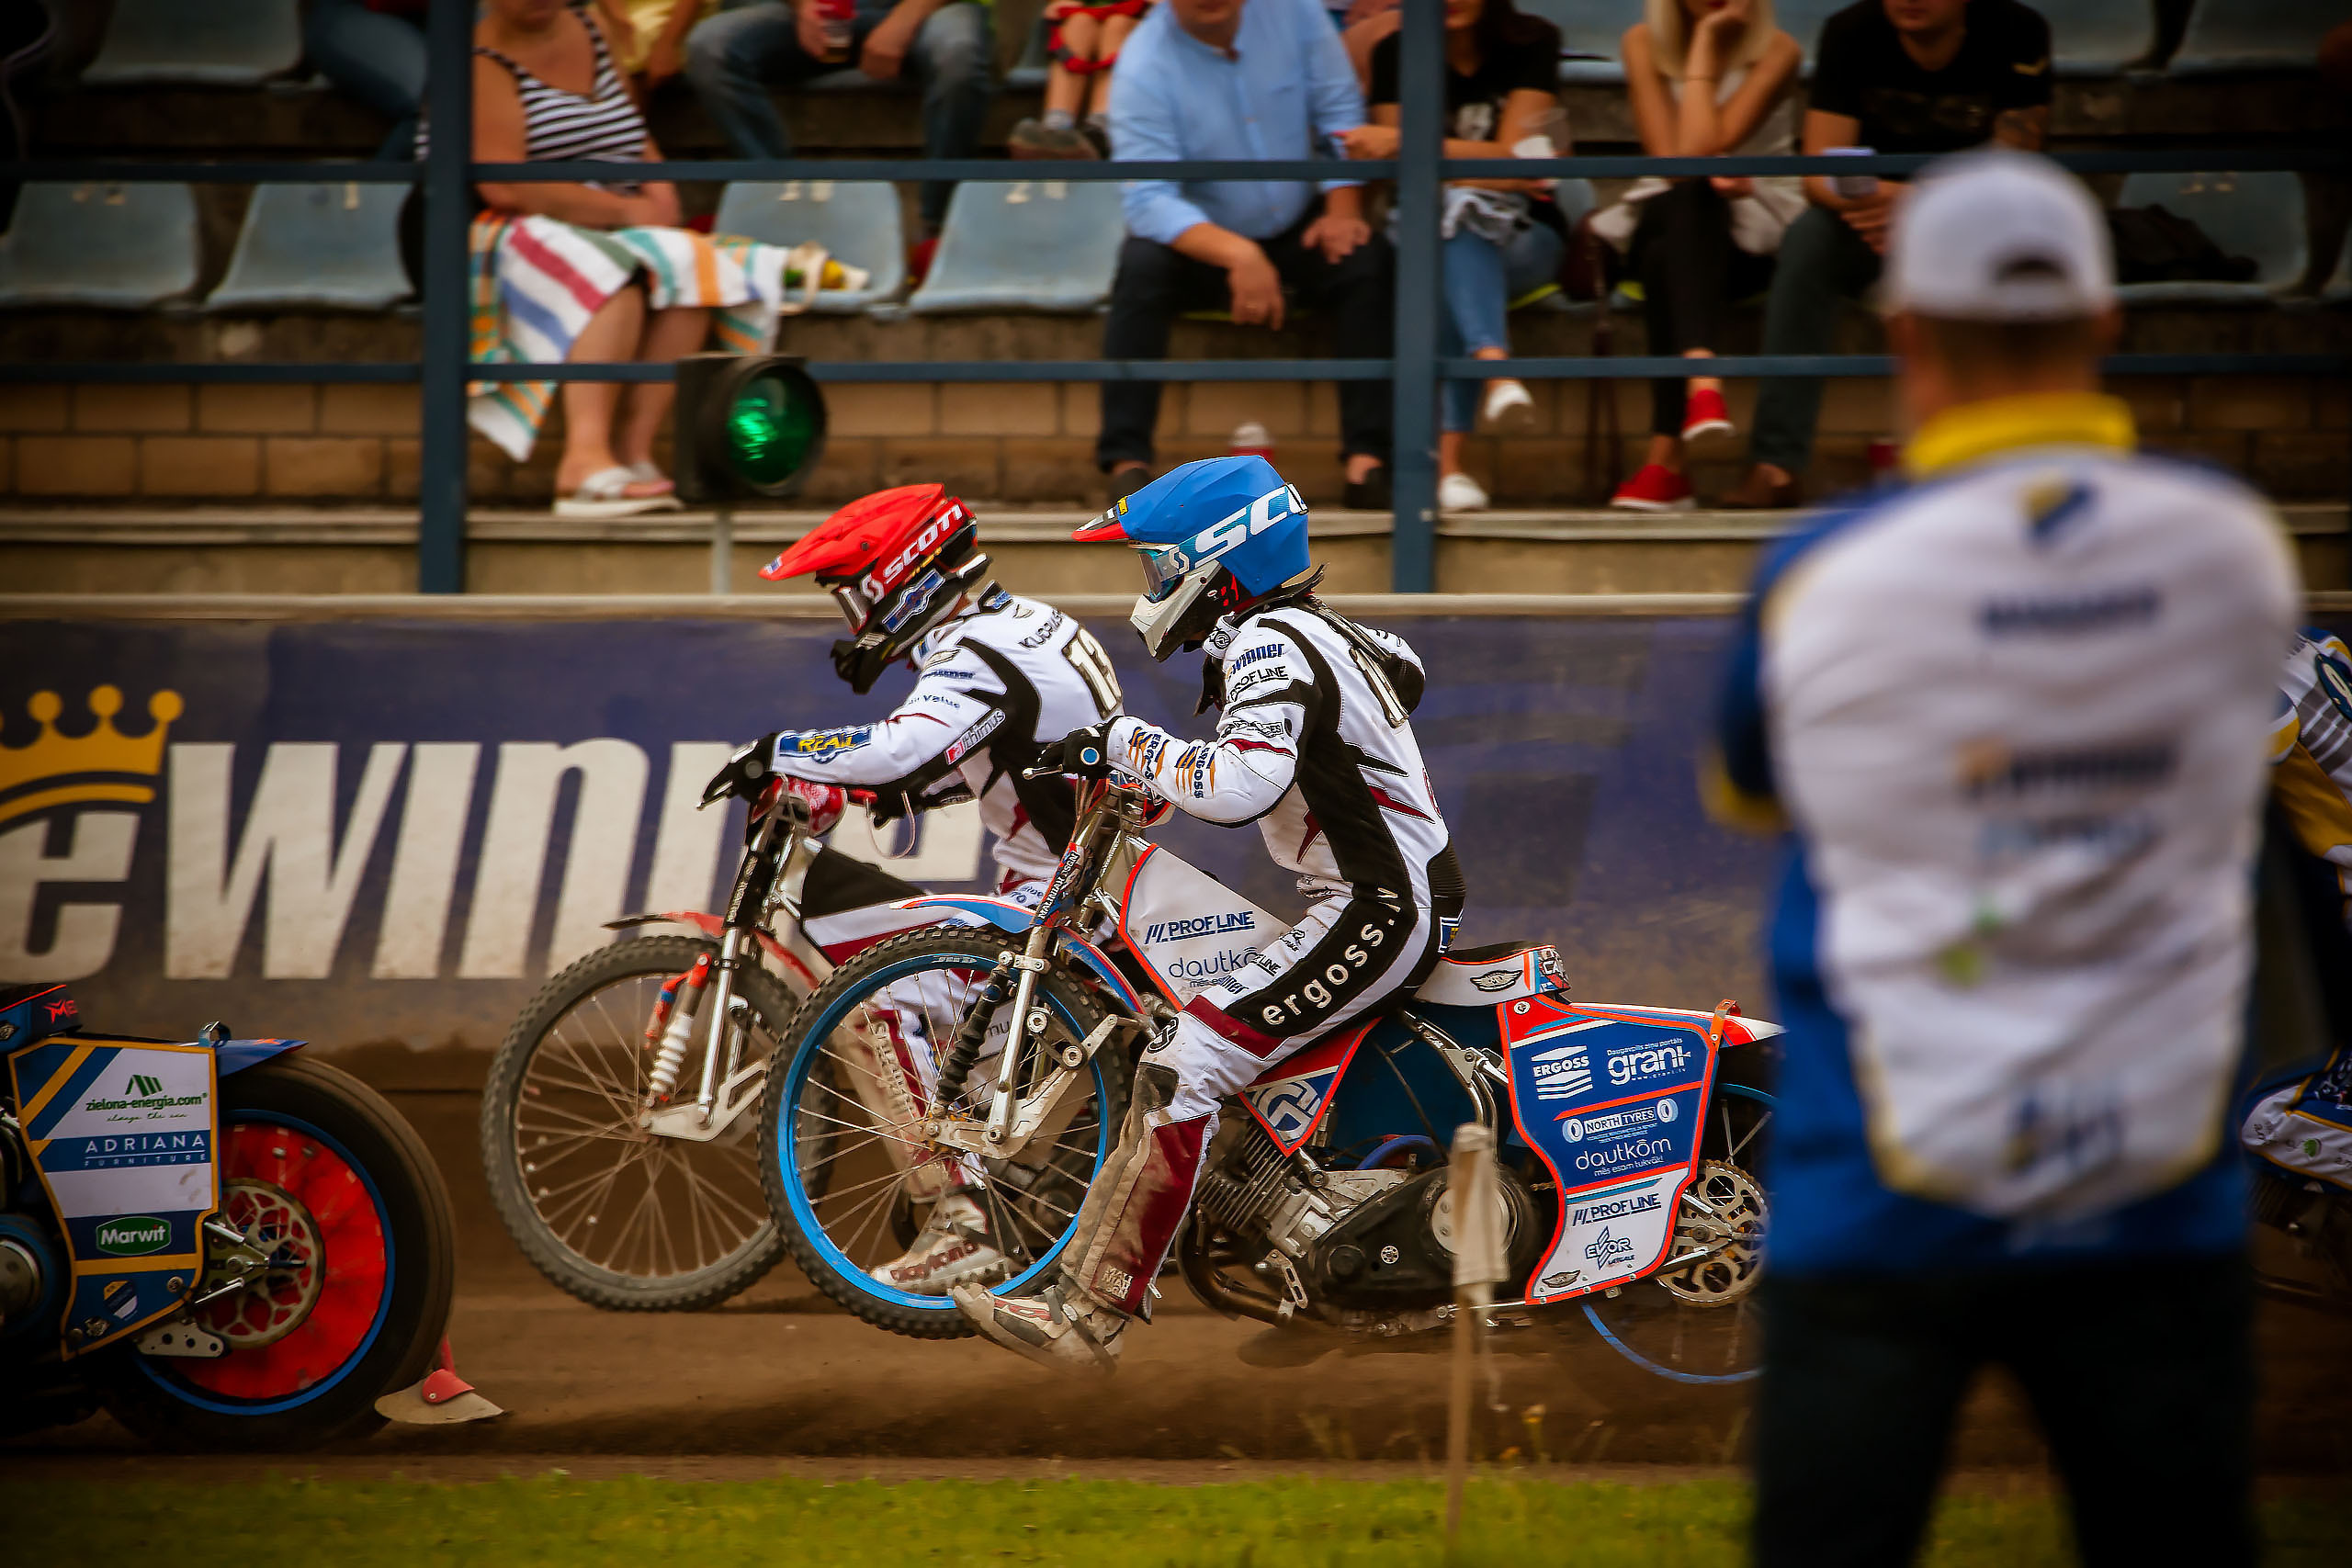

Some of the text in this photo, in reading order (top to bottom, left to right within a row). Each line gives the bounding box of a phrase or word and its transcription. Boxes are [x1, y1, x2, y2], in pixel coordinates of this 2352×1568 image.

[1532, 1055, 1590, 1077] ERGOSS
[1586, 1110, 1655, 1133] NORTH TYRES
[85, 1134, 206, 1154] ADRIANA
[84, 1154, 206, 1168] FURNITURE
[101, 1224, 166, 1246] Marwit
